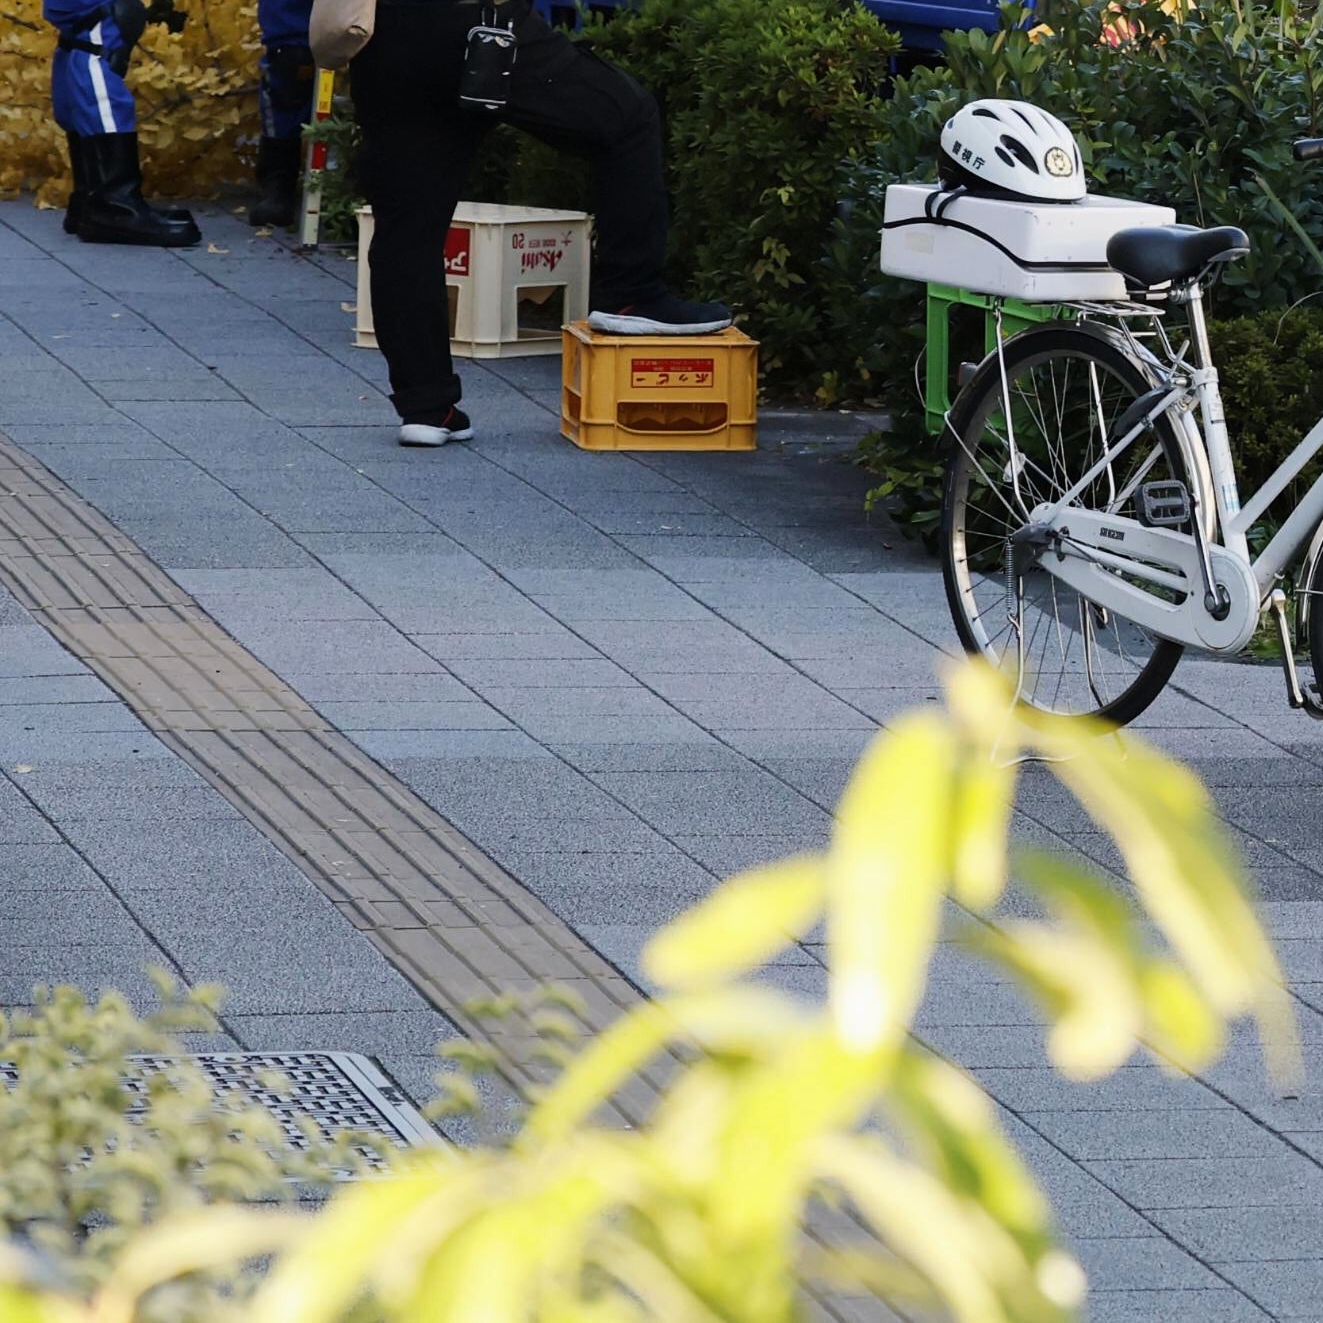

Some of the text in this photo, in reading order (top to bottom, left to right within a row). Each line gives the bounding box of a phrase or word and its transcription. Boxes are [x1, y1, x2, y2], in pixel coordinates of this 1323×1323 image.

[951, 140, 986, 170] 警視庁
[520, 249, 563, 275] Asahi
